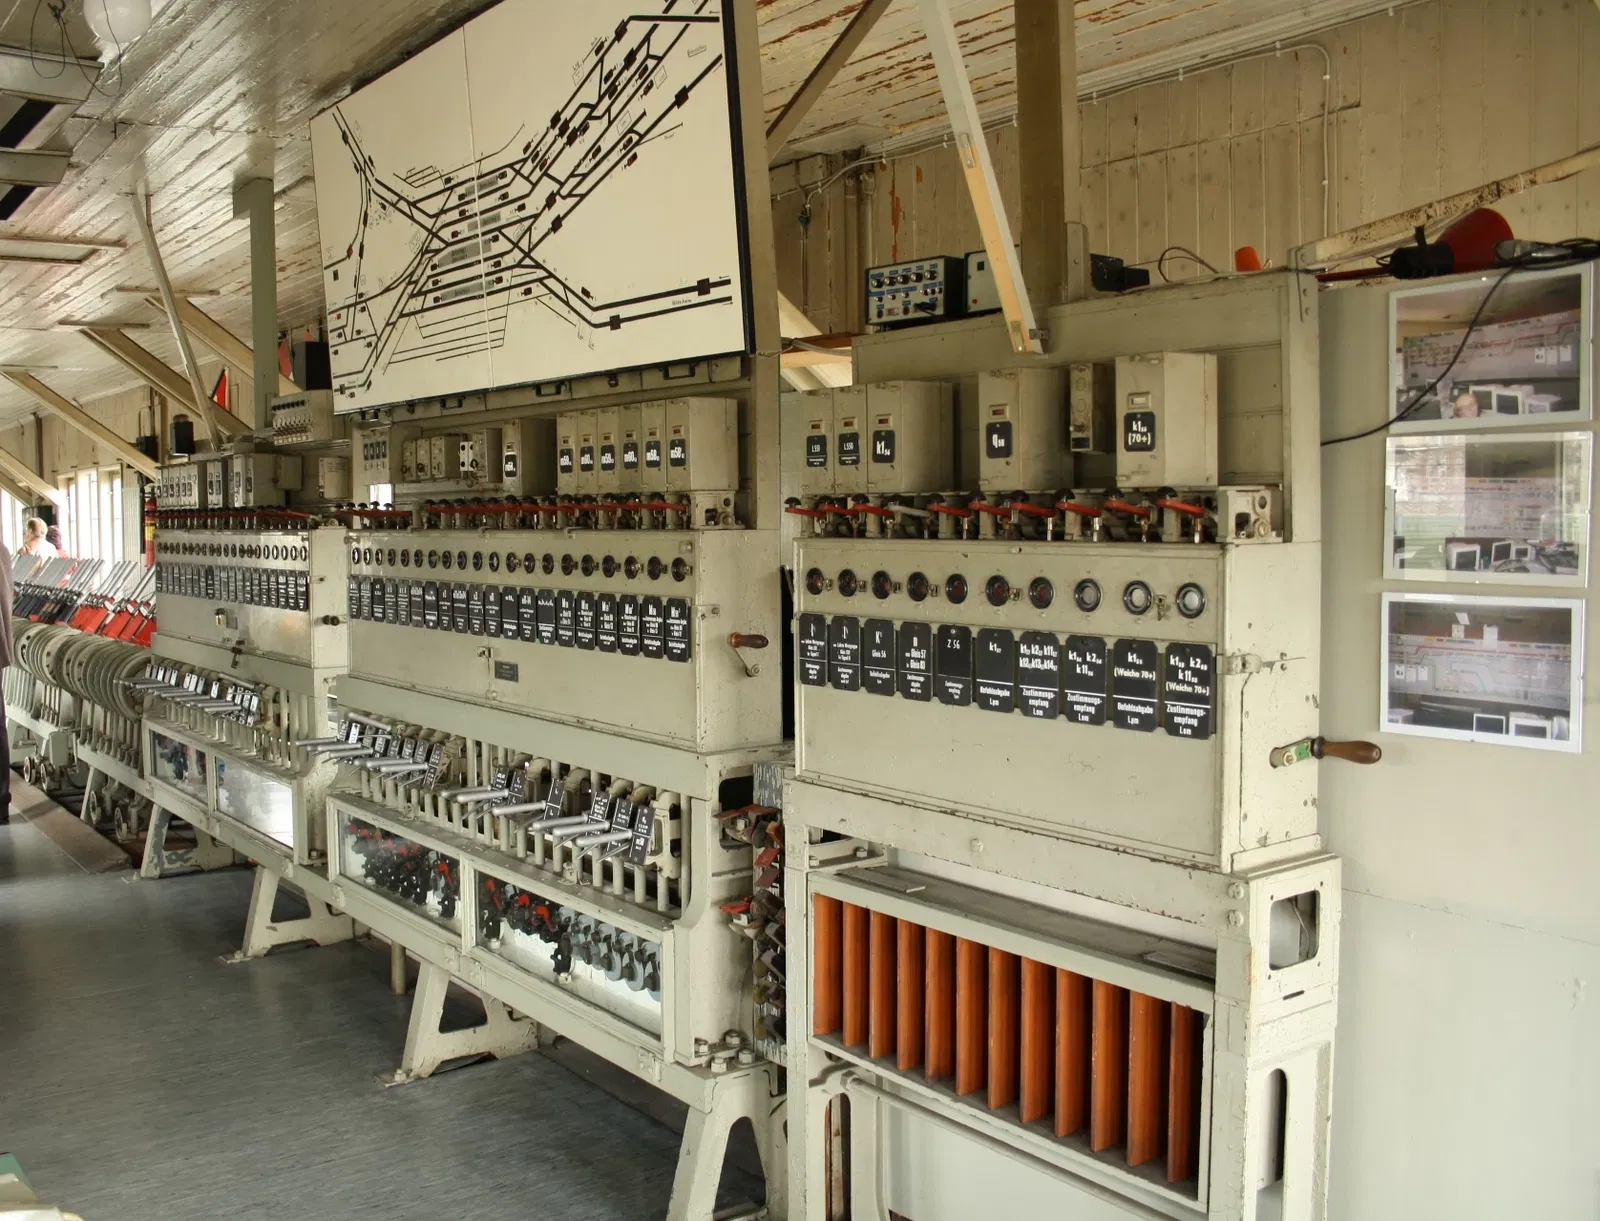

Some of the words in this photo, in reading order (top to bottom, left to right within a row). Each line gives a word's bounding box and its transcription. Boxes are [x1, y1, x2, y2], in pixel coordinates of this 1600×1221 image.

[1128, 432, 1151, 445] (70+)
[947, 639, 951, 648] Z
[953, 640, 960, 649] 56
[921, 650, 926, 659] 57
[1114, 668, 1140, 678] (Weiche
[1141, 670, 1155, 680] 70+)
[1166, 682, 1192, 692] (Weiche
[1194, 686, 1209, 696] 70+)
[1029, 699, 1049, 708] empfang
[1074, 704, 1095, 714] empfang
[1117, 702, 1153, 714] Befehlsabgabe
[1167, 705, 1206, 717] Zustimmungs-
[1174, 716, 1198, 727] empfang
